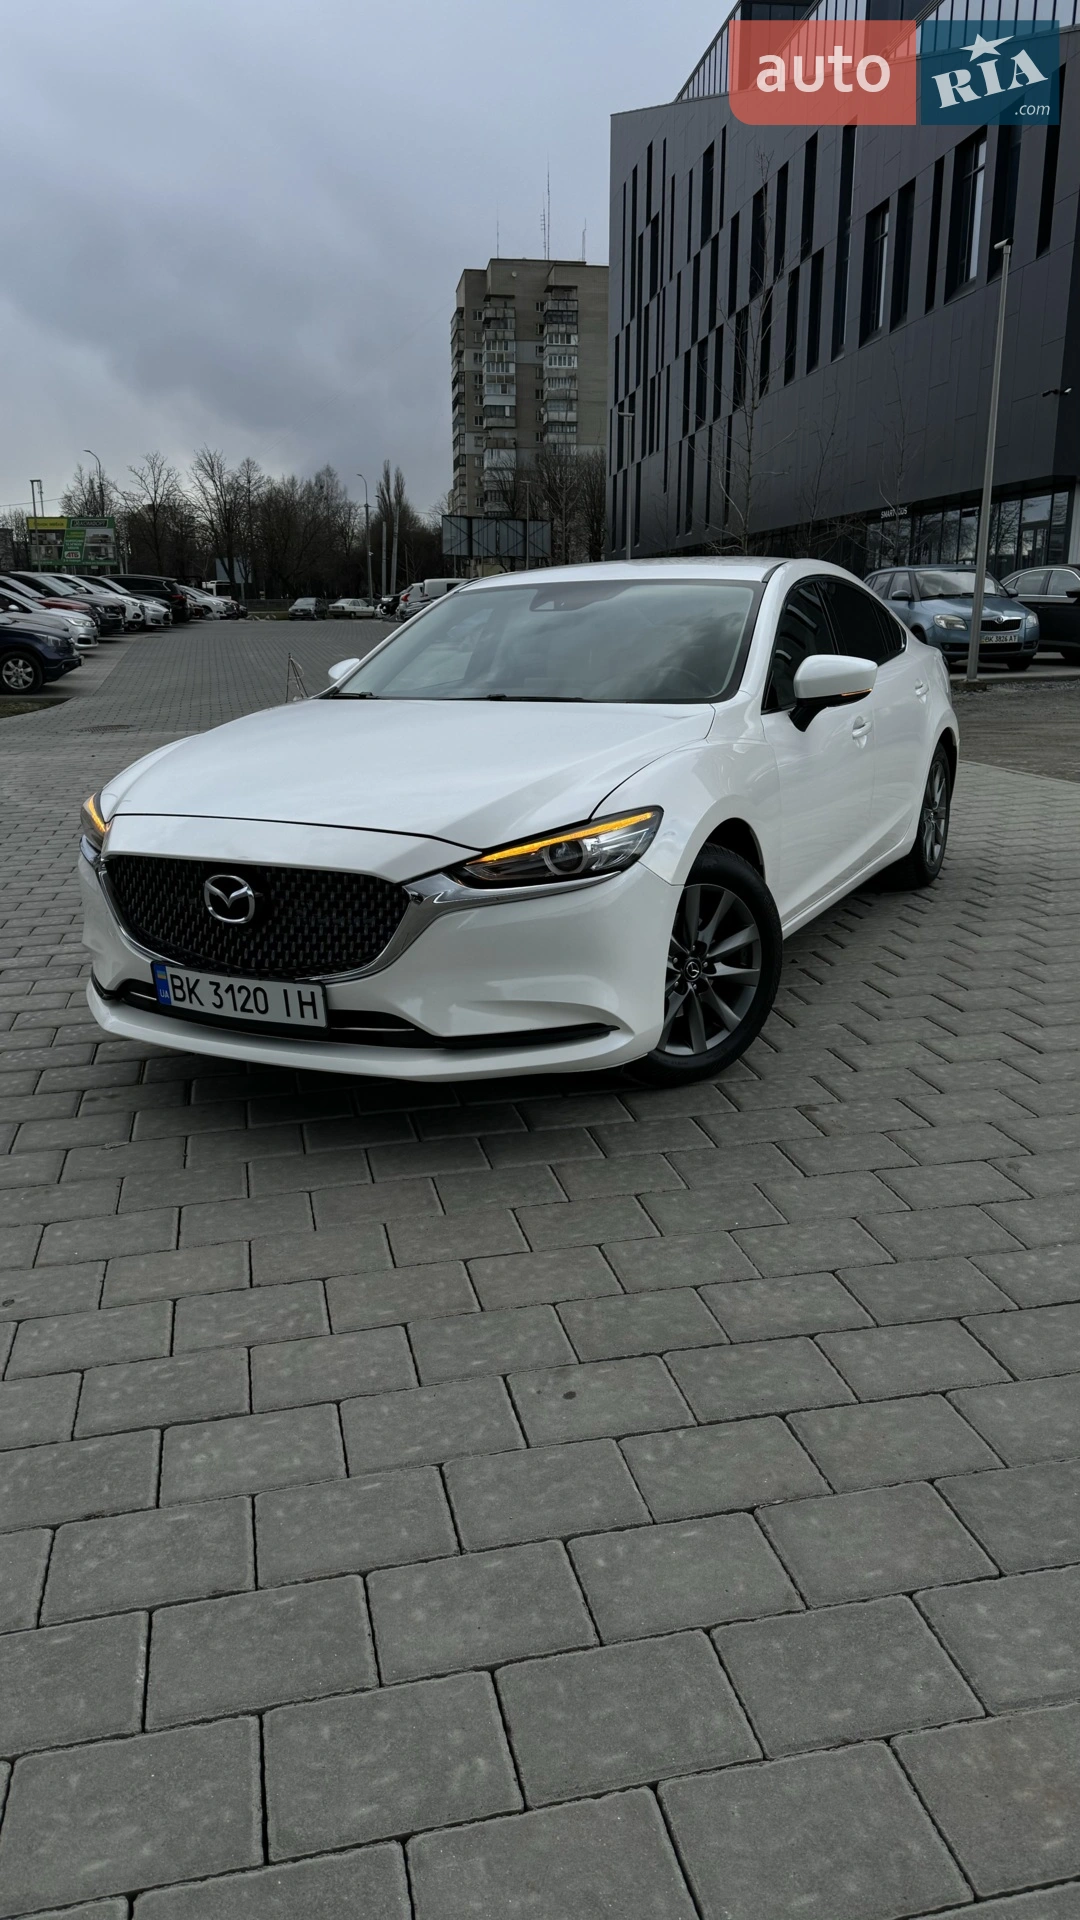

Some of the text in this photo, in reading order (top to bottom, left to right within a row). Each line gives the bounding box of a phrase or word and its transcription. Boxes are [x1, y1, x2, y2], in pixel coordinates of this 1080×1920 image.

[159, 990, 169, 999] UA
[170, 974, 318, 1019] BK 3120 IH
